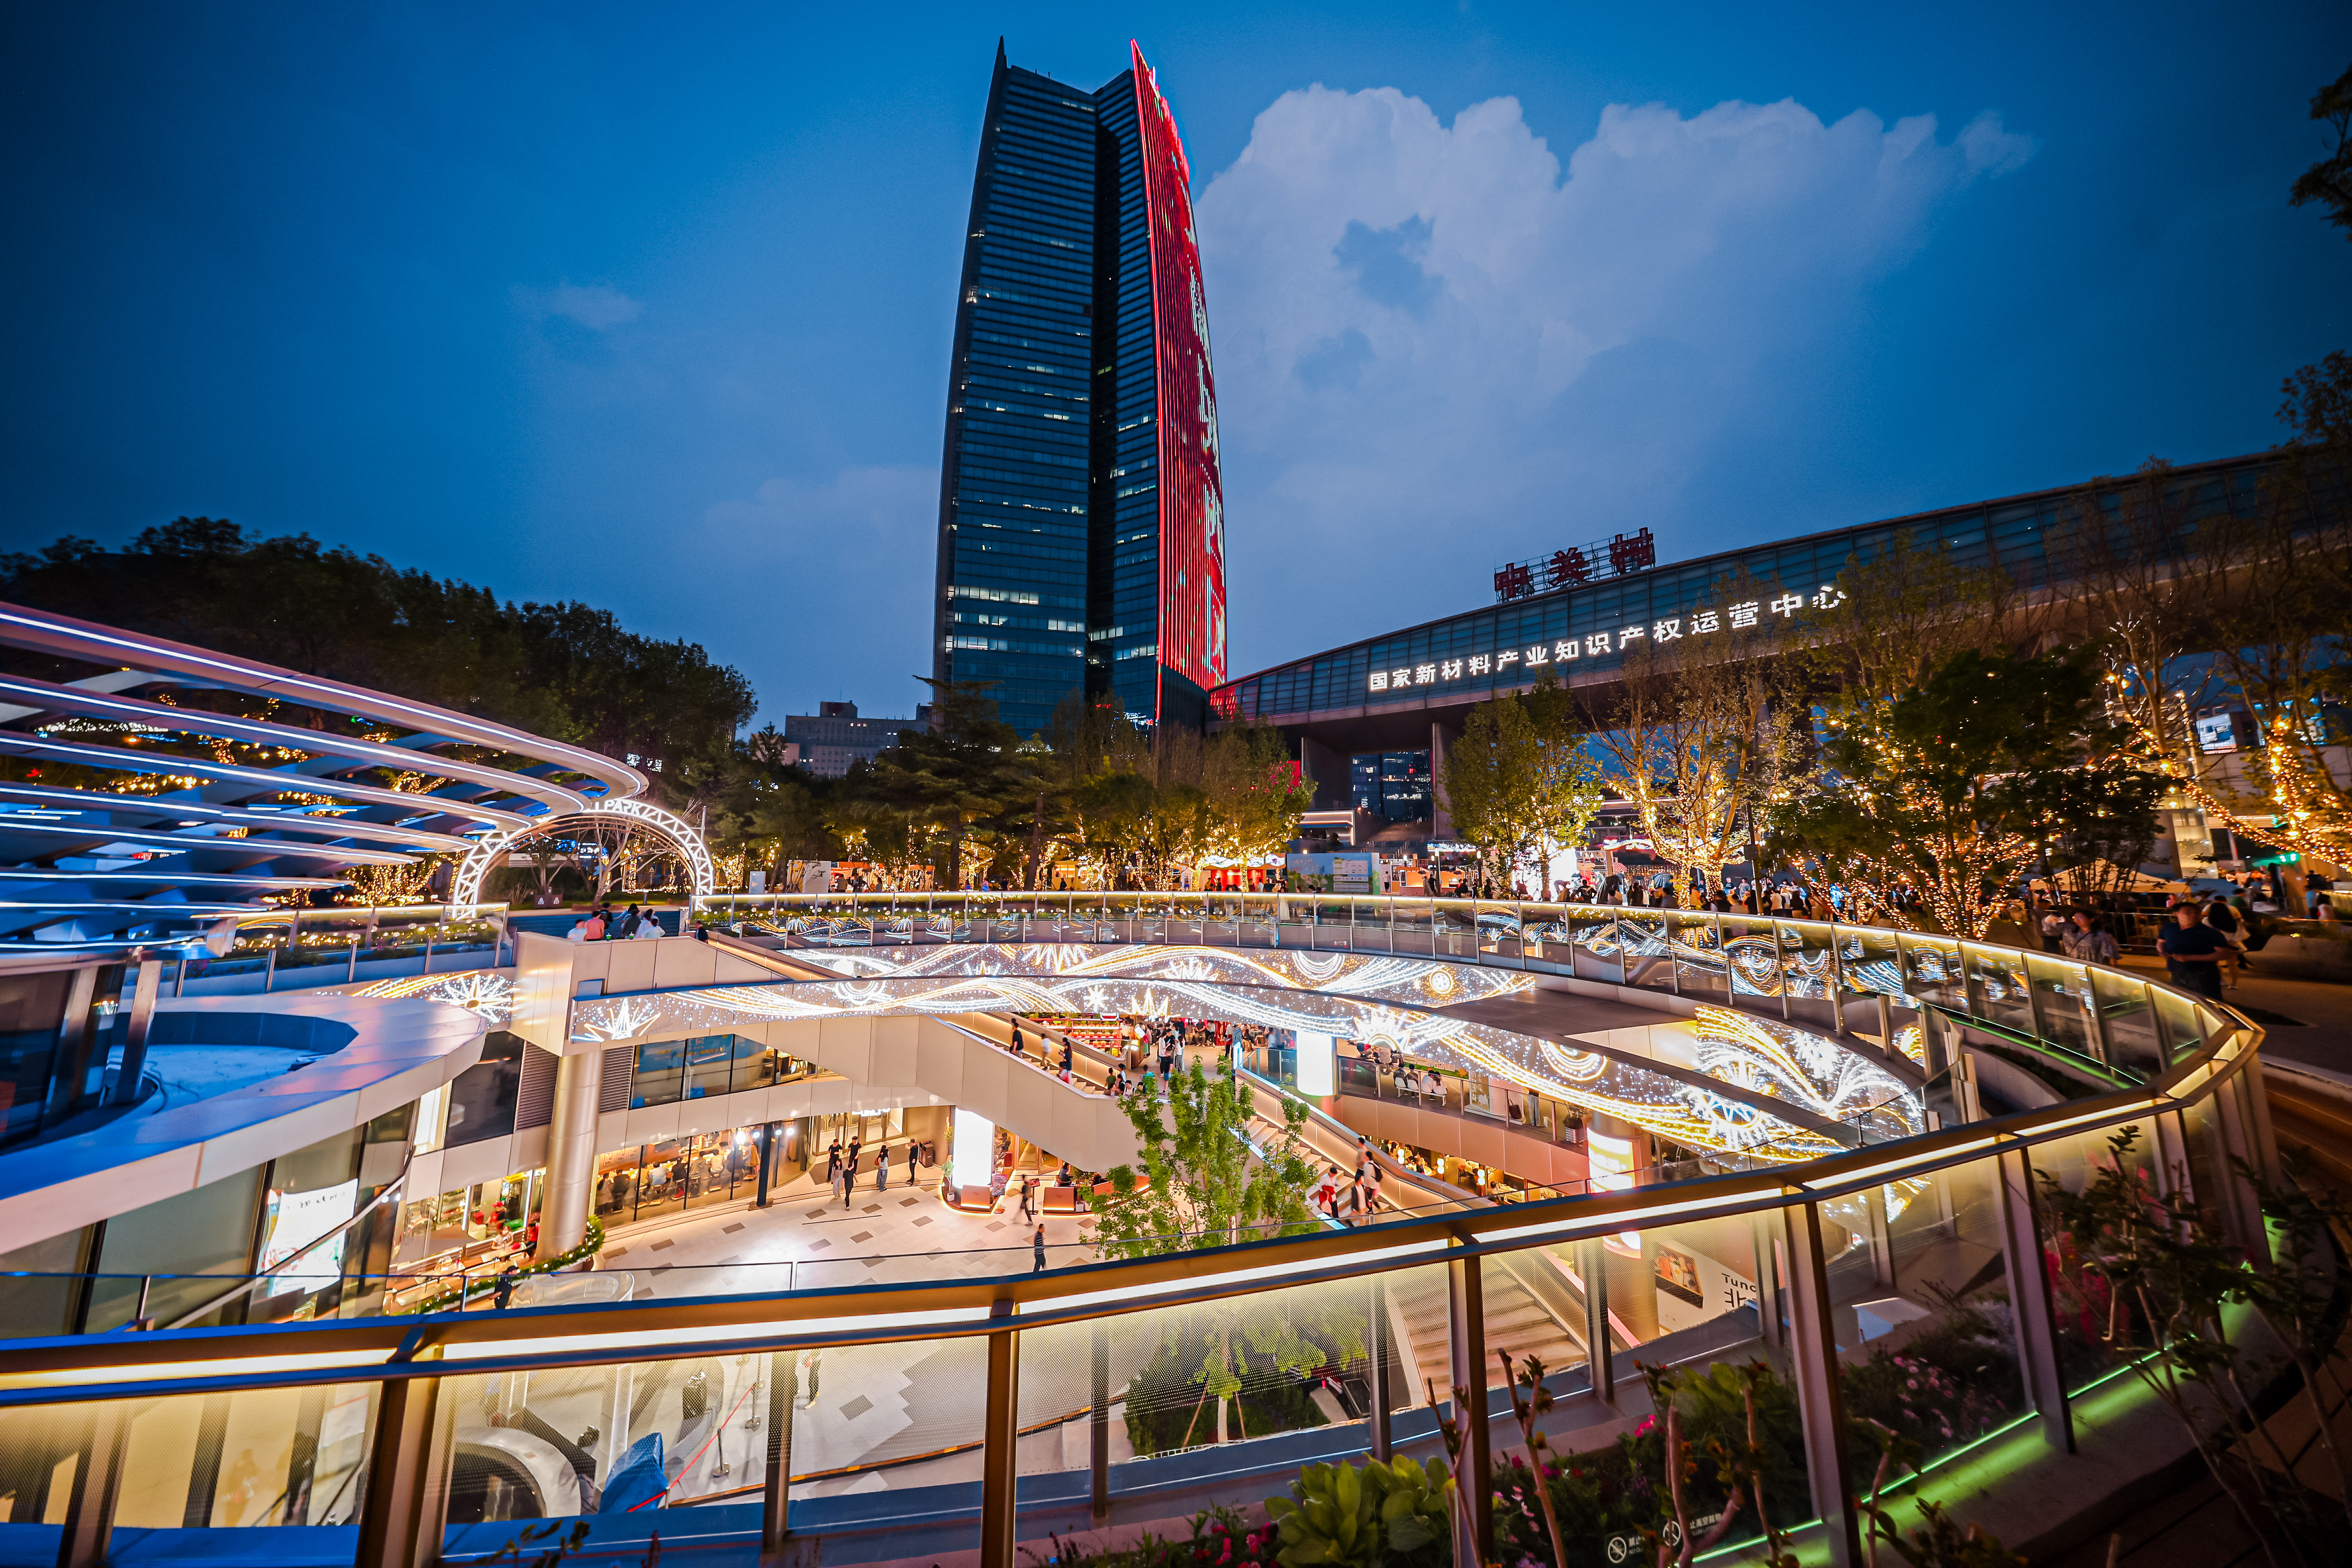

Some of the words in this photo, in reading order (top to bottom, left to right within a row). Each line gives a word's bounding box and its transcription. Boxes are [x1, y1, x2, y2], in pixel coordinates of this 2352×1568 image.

[1494, 527, 1654, 598] 中关村
[1370, 585, 1847, 691] 国家新材料产业知识产权运营中心
[1629, 1535, 1645, 1547] 禁止
